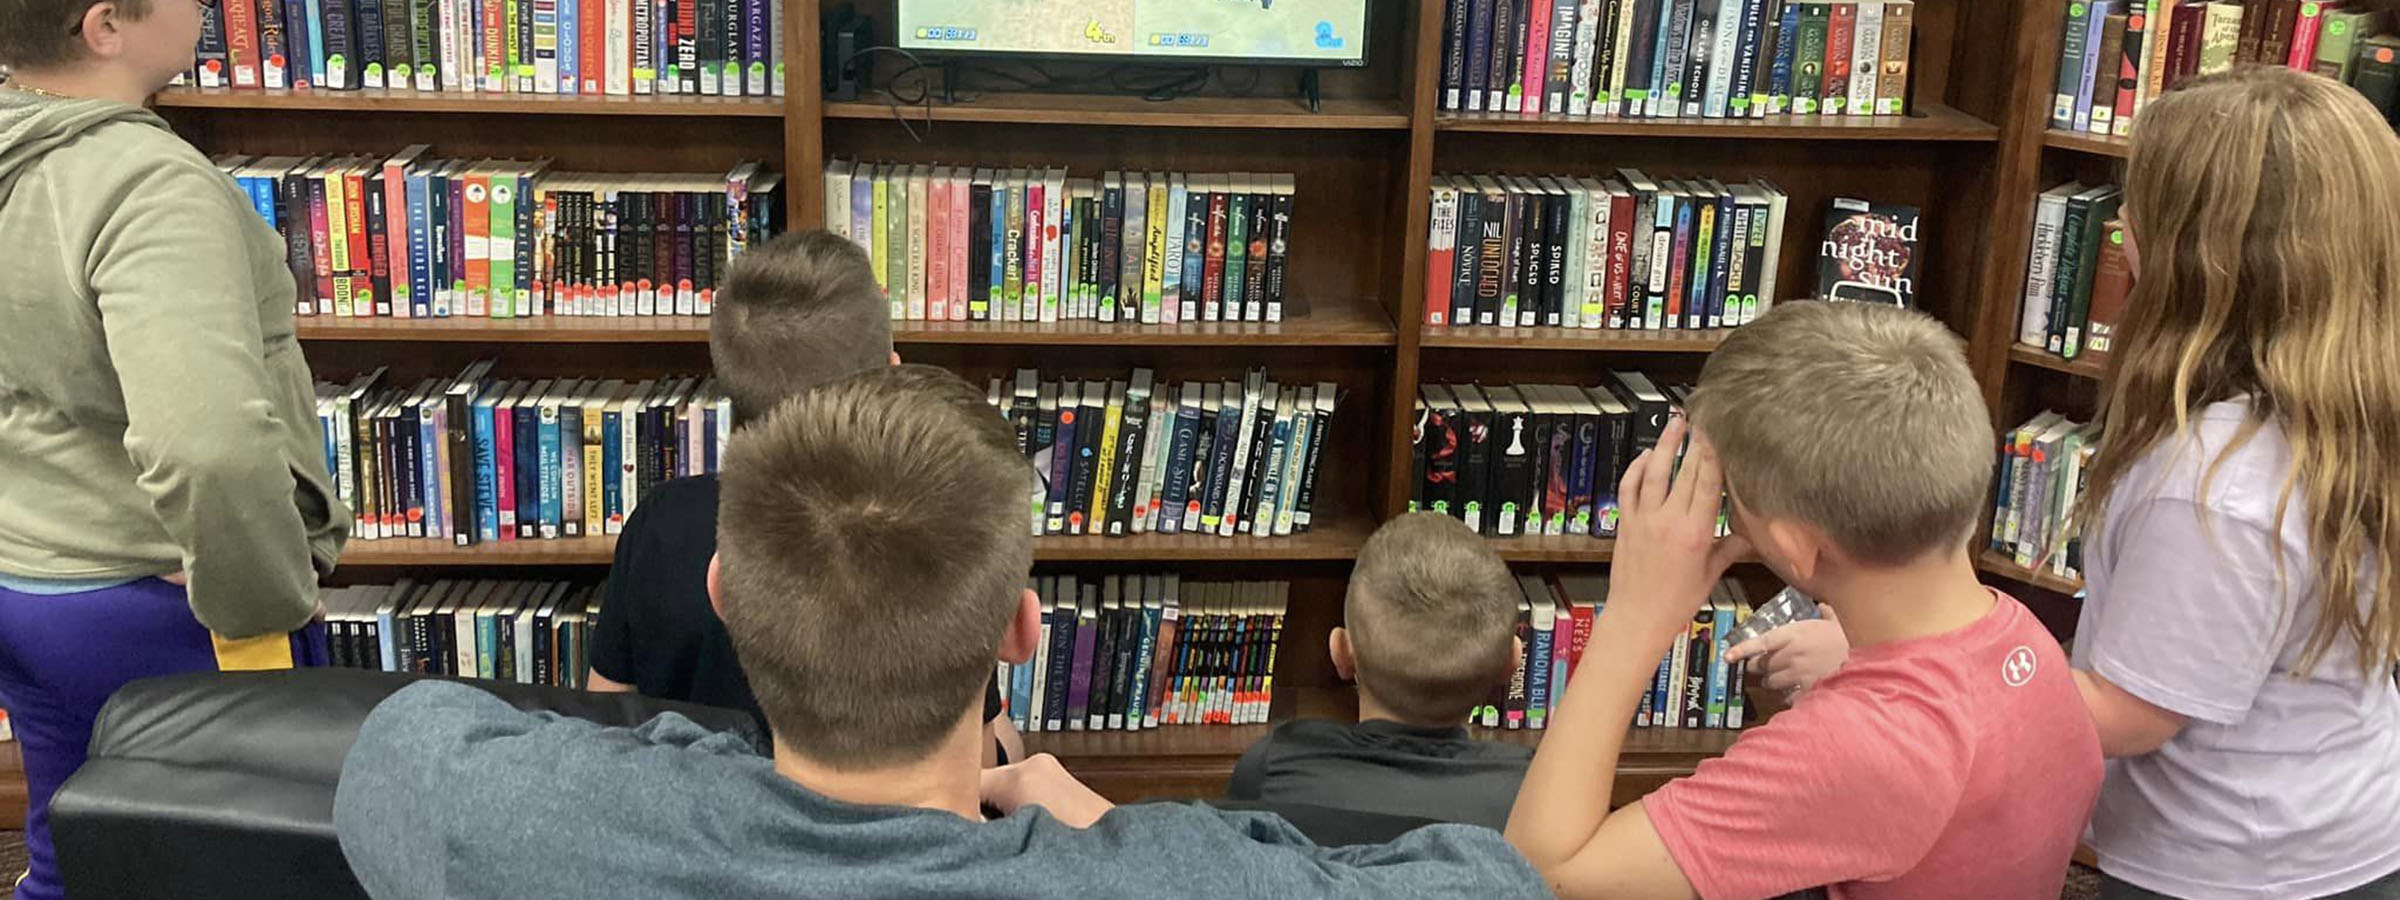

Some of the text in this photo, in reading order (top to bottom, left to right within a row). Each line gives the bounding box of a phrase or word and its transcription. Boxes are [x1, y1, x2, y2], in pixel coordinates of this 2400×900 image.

[678, 38, 696, 69] ZERO
[1495, 6, 1508, 77] DARKEST MERCY
[1553, 6, 1574, 60] IMAGINE
[1721, 15, 1736, 48] SONG
[1451, 39, 1461, 81] SHADOWS
[1690, 19, 1709, 98] OUR LAST ECHOES
[1738, 45, 1753, 98] VANISHING
[1614, 231, 1628, 252] ONE
[1729, 209, 1748, 290] WHITE JACKET
[1752, 211, 1765, 245] TYPEE
[1859, 214, 1919, 242] mid
[1006, 229, 1020, 281] Cracker!
[1147, 226, 1162, 282] Amplified
[1168, 235, 1183, 276] TAROT
[1479, 238, 1502, 297] UNLOCKED
[1528, 243, 1541, 285] SPLICED
[1549, 245, 1562, 285] SPIKED
[1614, 263, 1624, 275] US
[1652, 235, 1667, 289] dream girl
[1821, 234, 1900, 271] night
[2029, 223, 2054, 297] Huckleberry Finn
[2058, 213, 2083, 295] Complete Dickens
[1631, 285, 1642, 314] COURT
[1170, 427, 1193, 498] CLASH STEEL
[1269, 447, 1284, 481] WRINKLE
[1274, 437, 1285, 445] A
[477, 437, 494, 512] SAVE STEVE
[541, 444, 550, 504] MULTITUDES
[550, 451, 558, 499] WE CONTAIN
[567, 471, 576, 516] OUTSIDE
[589, 450, 599, 519] THEY WENT LEFT
[1075, 460, 1090, 510] SATELLIT
[1306, 468, 1316, 489] PLANET
[1136, 637, 1151, 680] GENUINE
[1531, 632, 1551, 686] RAMONA
[1572, 618, 1584, 653] NESS
[1050, 622, 1070, 719] SPIN THE DAWN
